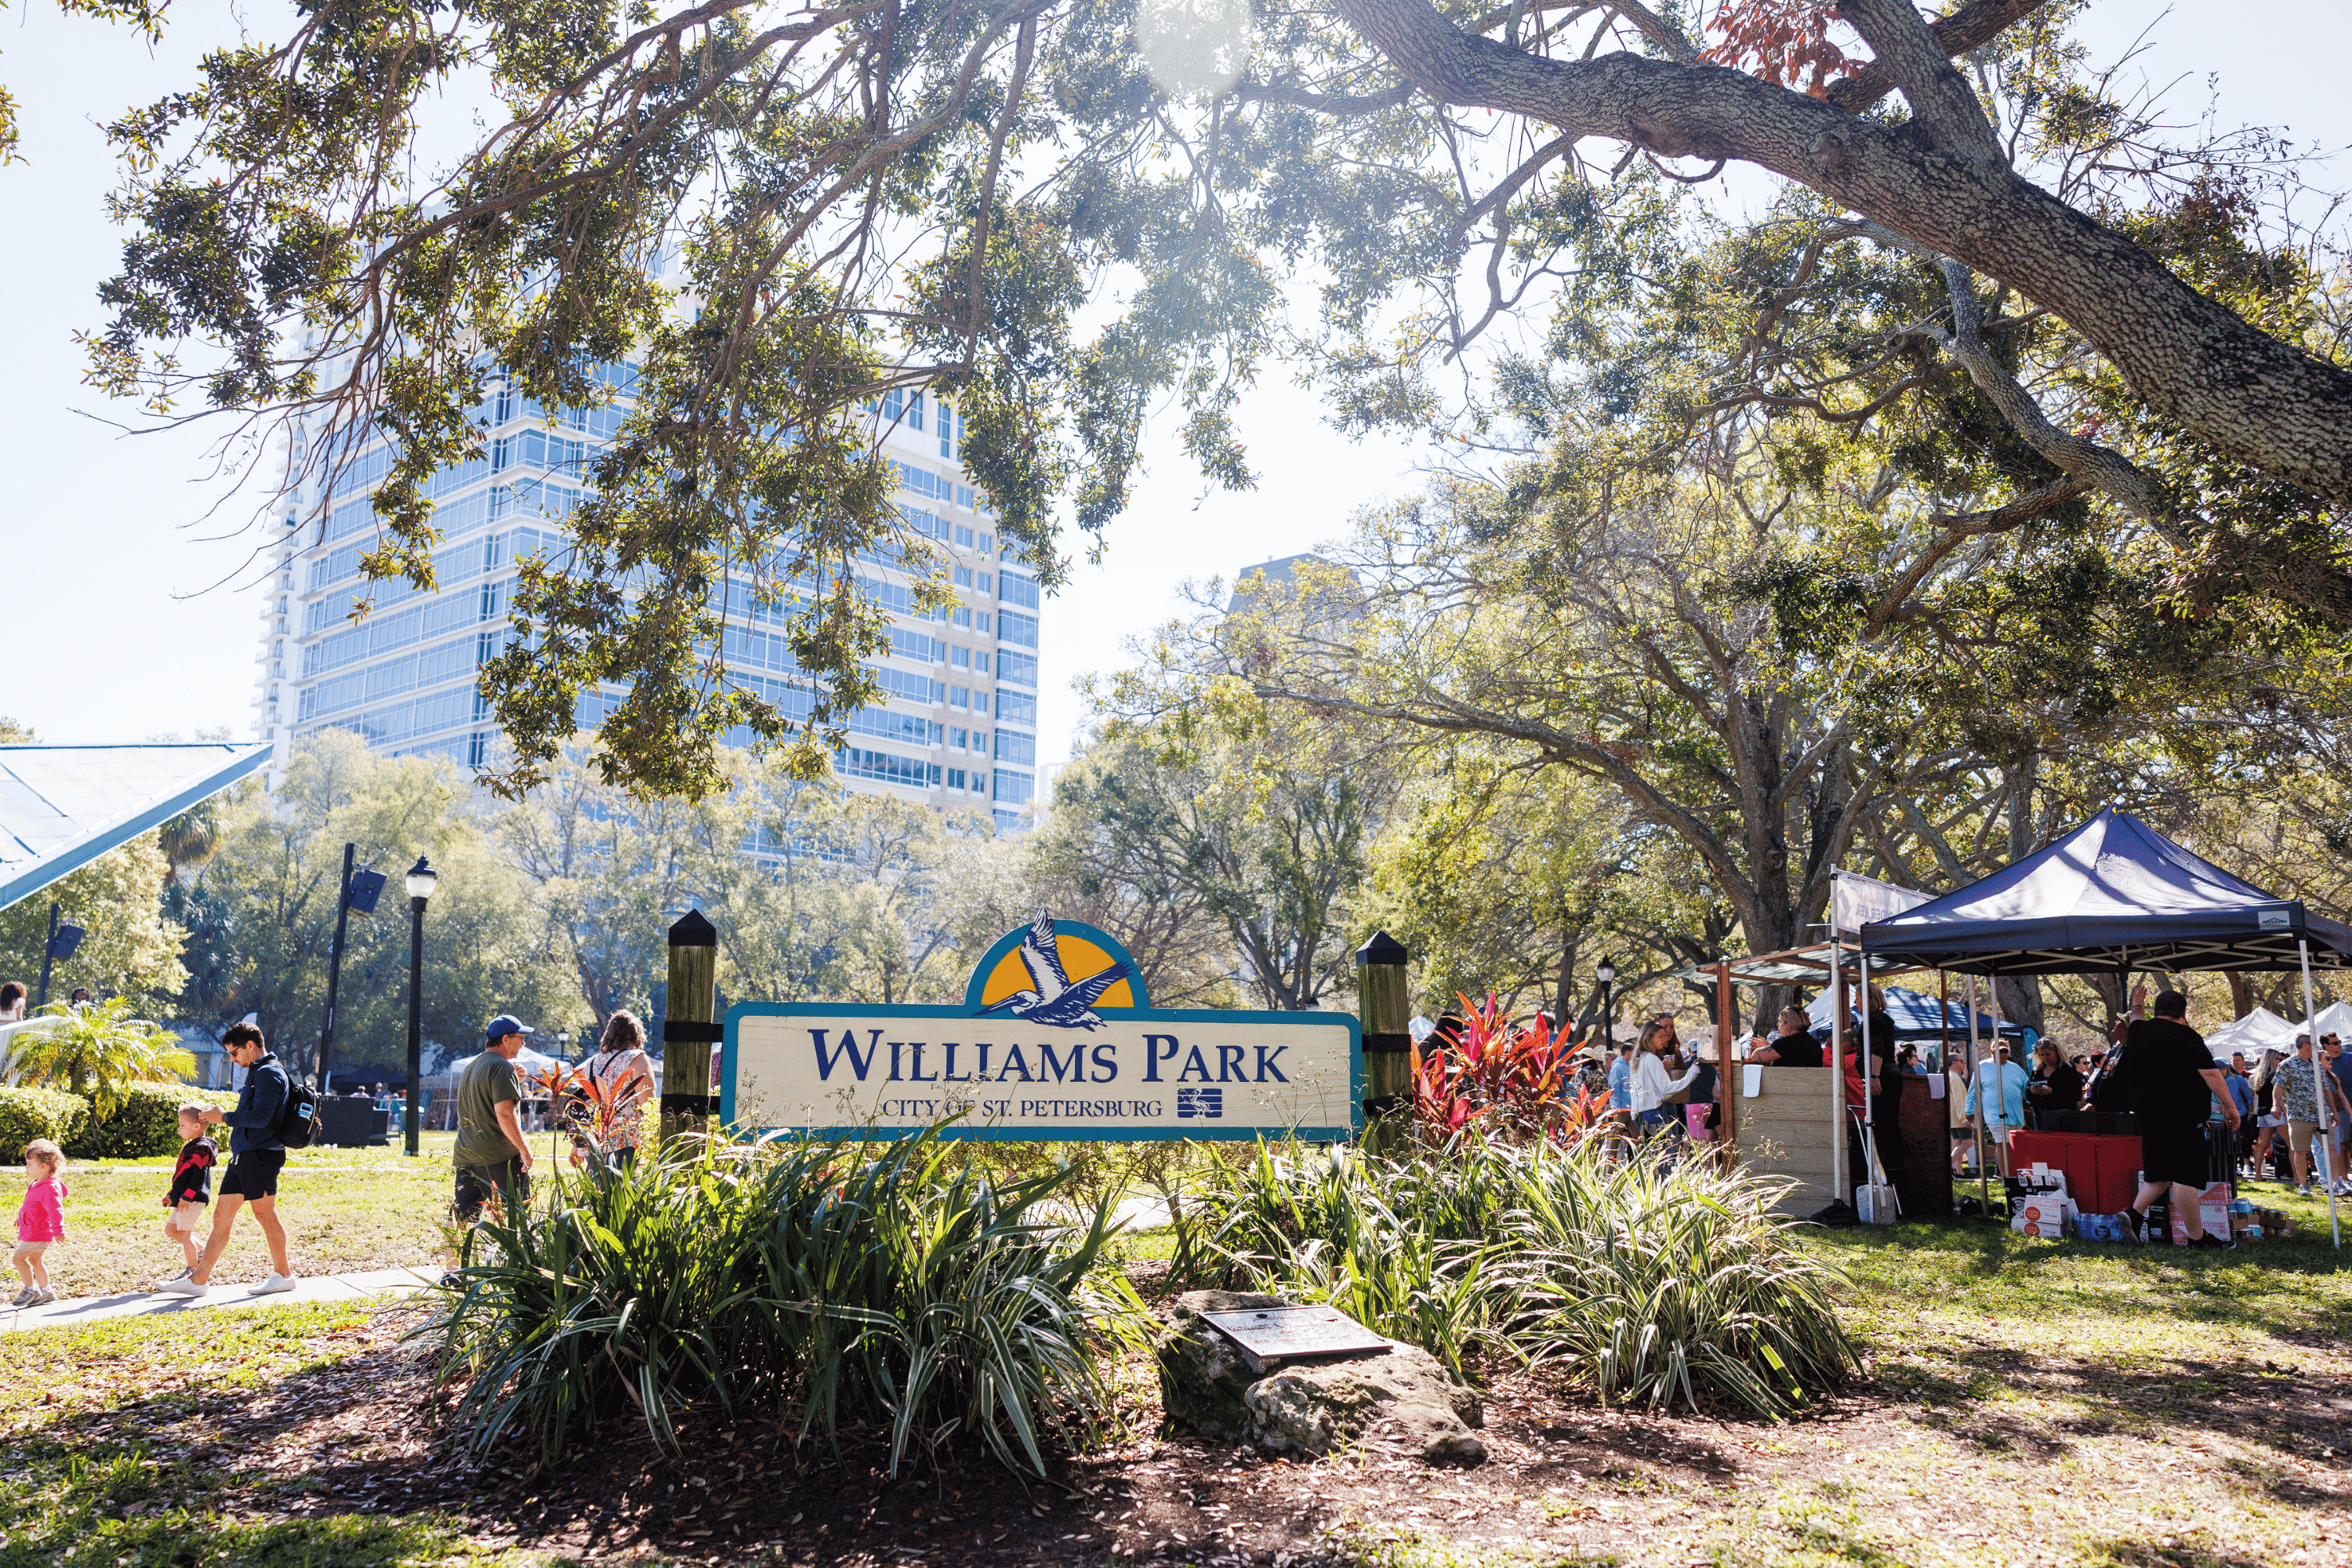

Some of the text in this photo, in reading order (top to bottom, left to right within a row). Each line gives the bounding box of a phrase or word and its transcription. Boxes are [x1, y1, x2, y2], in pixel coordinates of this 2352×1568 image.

[807, 1029, 1290, 1084] WILLIAMS PARK
[882, 1099, 1163, 1117] CITY OF ST. PETERSBURG
